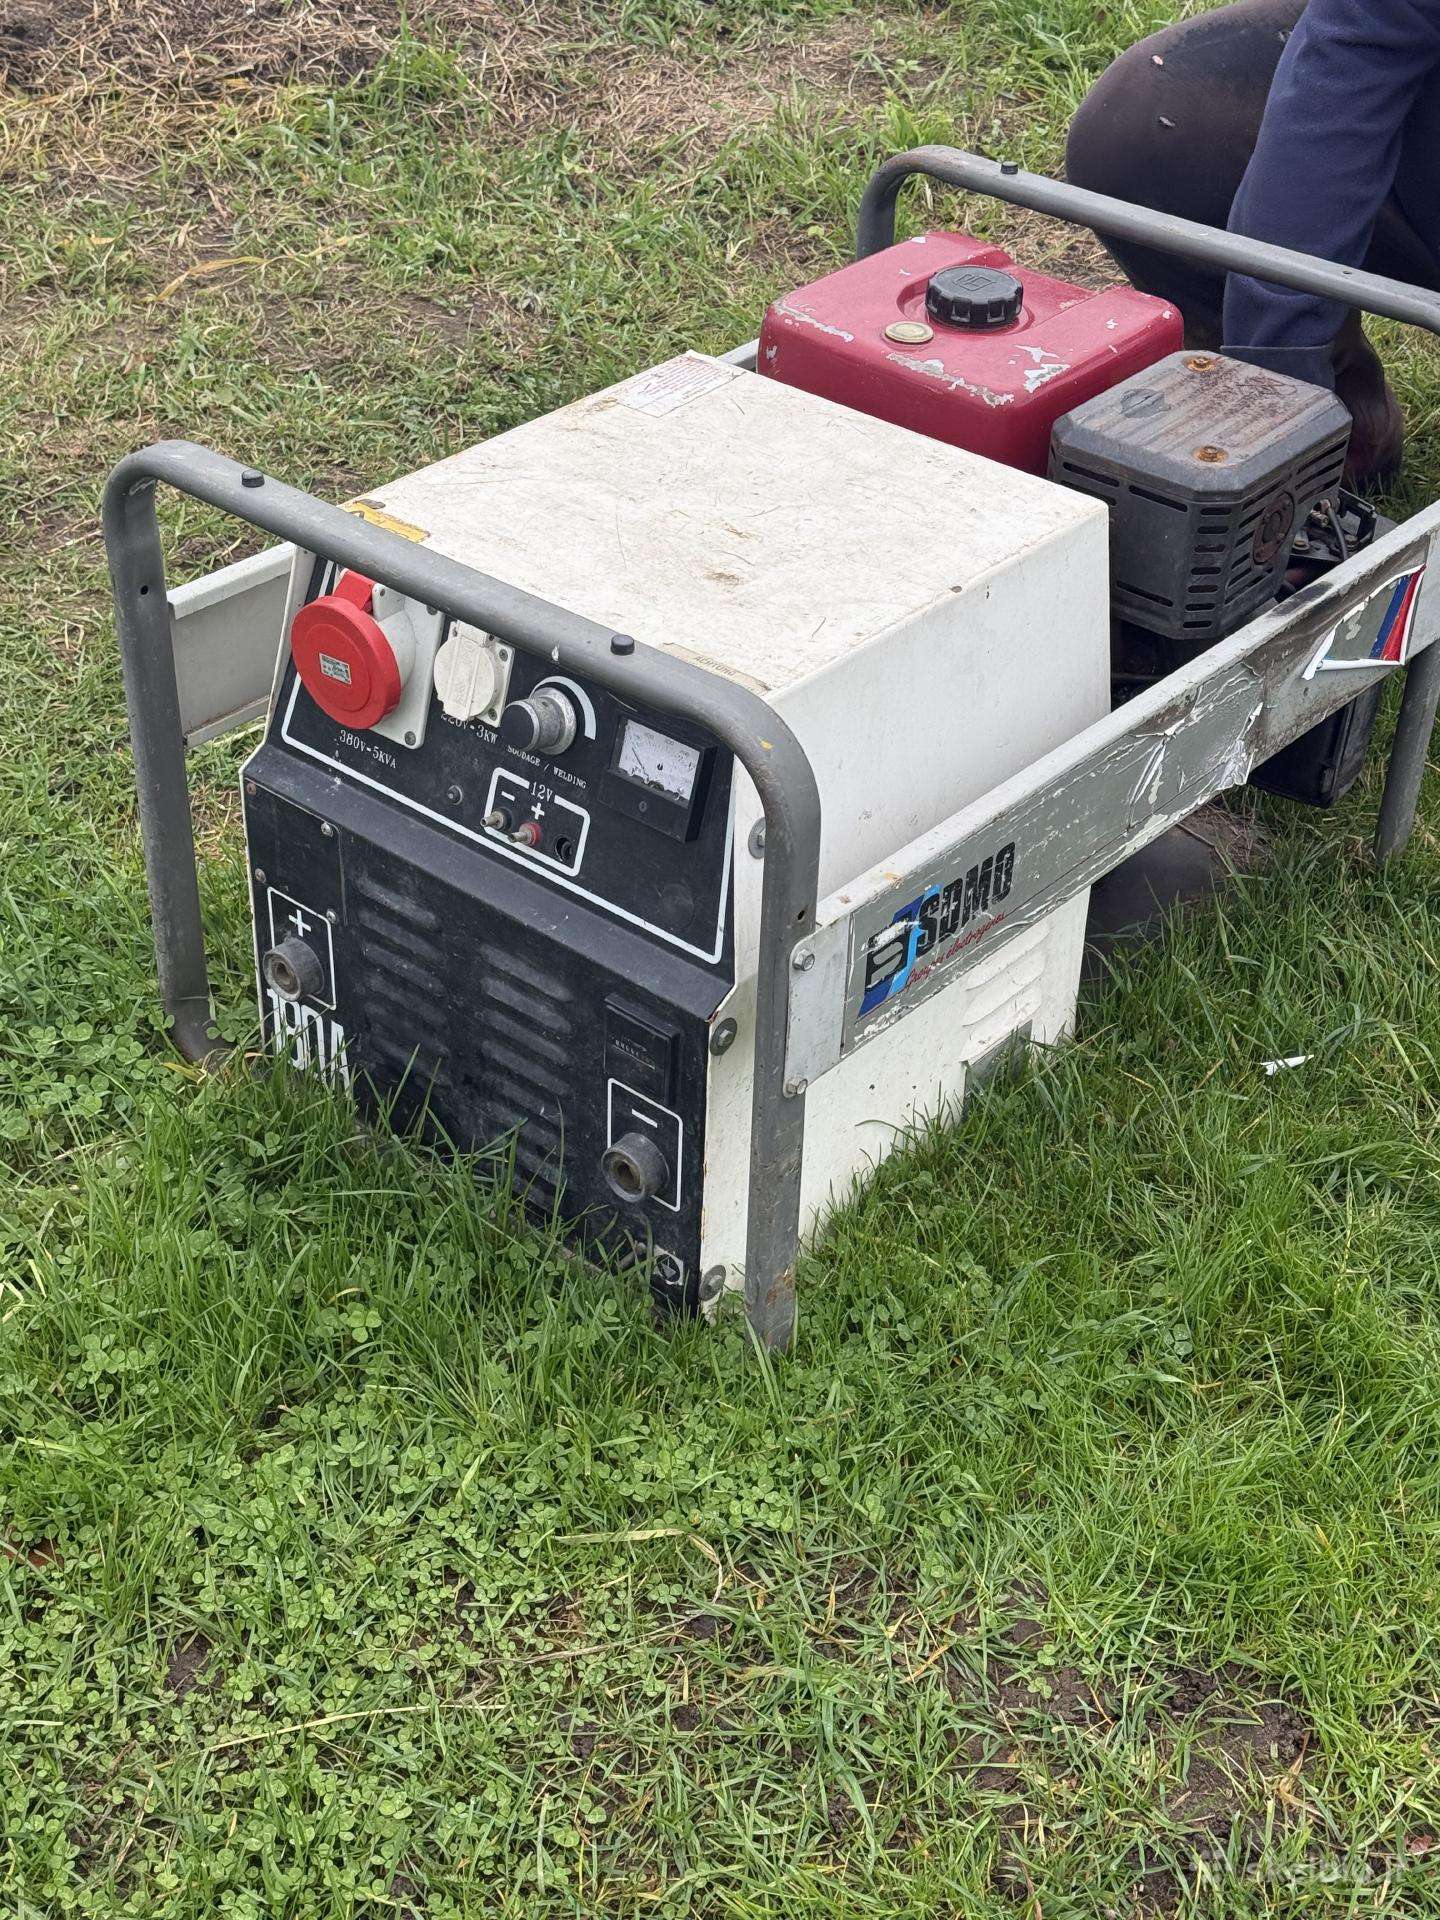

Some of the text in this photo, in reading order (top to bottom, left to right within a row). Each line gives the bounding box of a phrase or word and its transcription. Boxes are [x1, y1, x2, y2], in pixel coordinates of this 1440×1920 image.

[339, 729, 397, 769] 380V-5KVA
[507, 744, 541, 767] SOUDAGE
[553, 765, 587, 789] WELDING
[530, 781, 554, 803] 12V
